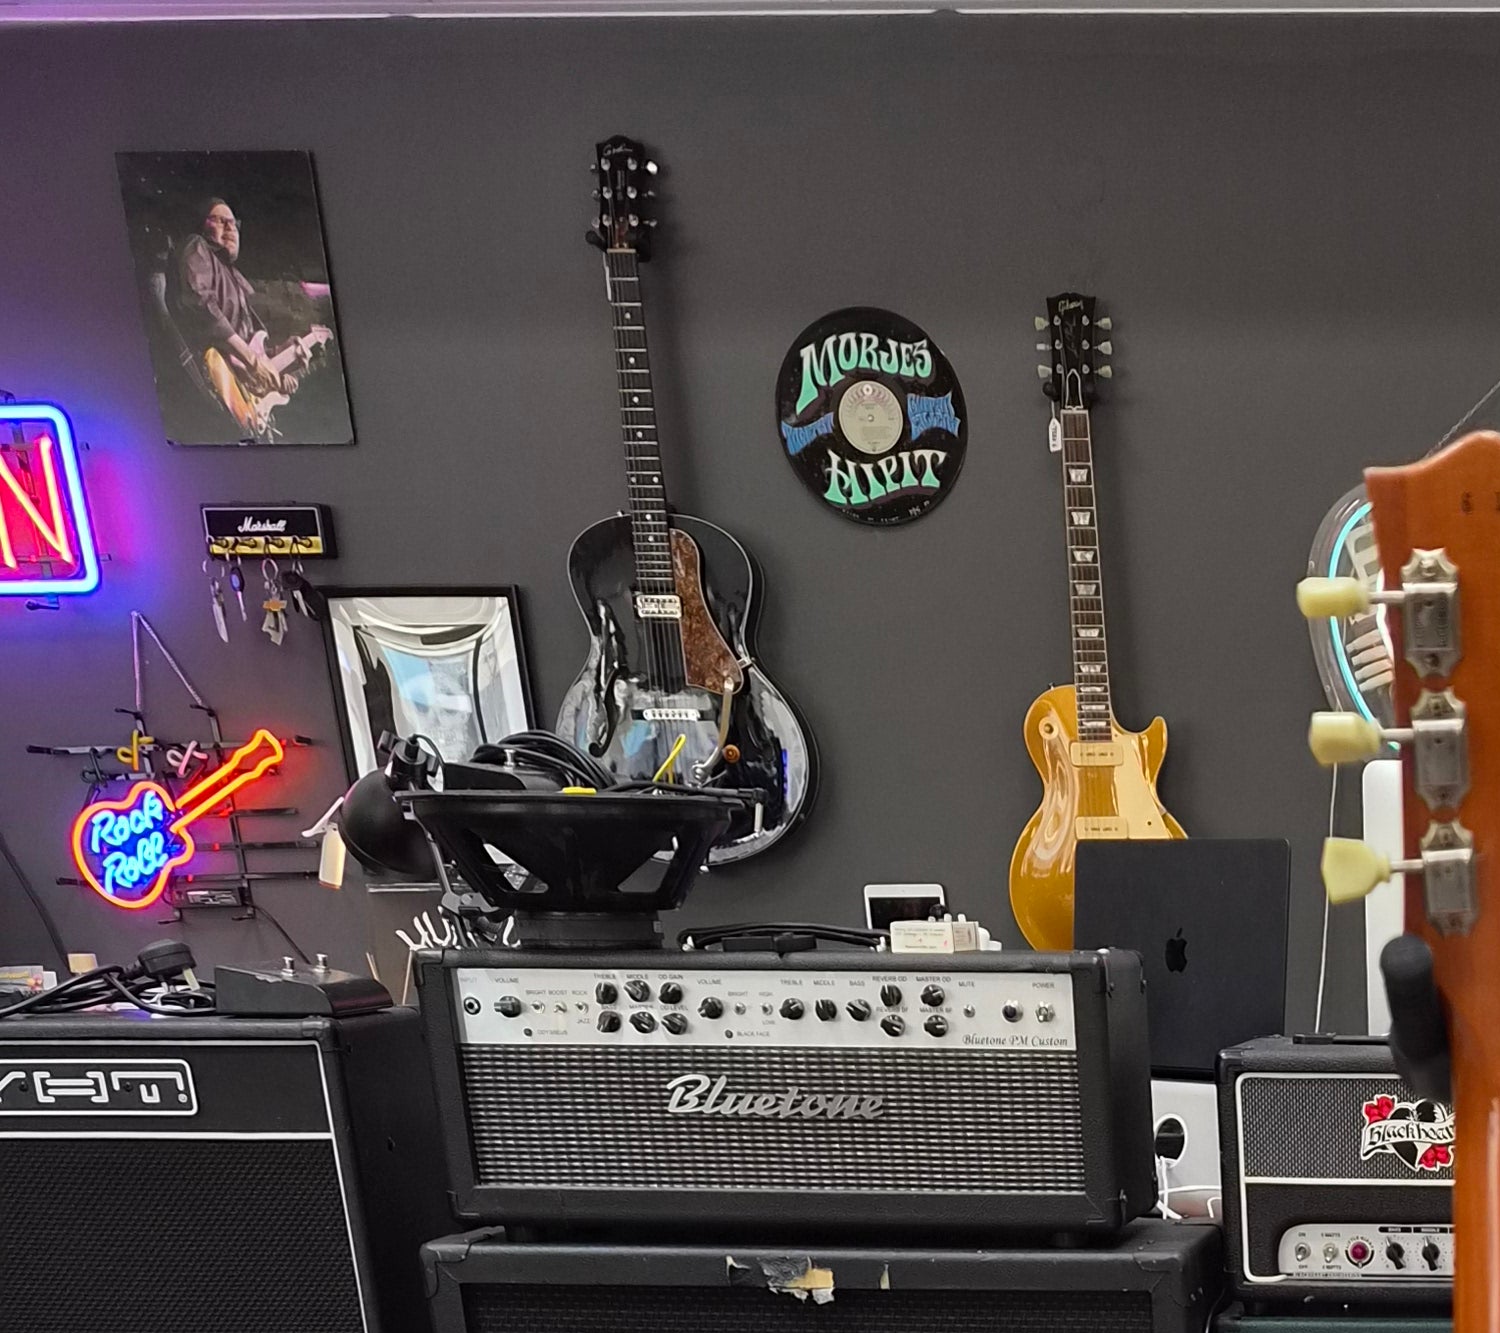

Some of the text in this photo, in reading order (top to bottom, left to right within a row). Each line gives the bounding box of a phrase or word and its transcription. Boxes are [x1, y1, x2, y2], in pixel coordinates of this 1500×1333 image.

[796, 332, 932, 415] MORJES
[824, 449, 947, 505] HIPIT
[237, 516, 287, 532] Marshall
[91, 790, 164, 853] Rock
[103, 832, 169, 895] Roll
[962, 1035, 1068, 1047] Bluetone PM Custom
[666, 1073, 884, 1119] Bluetone
